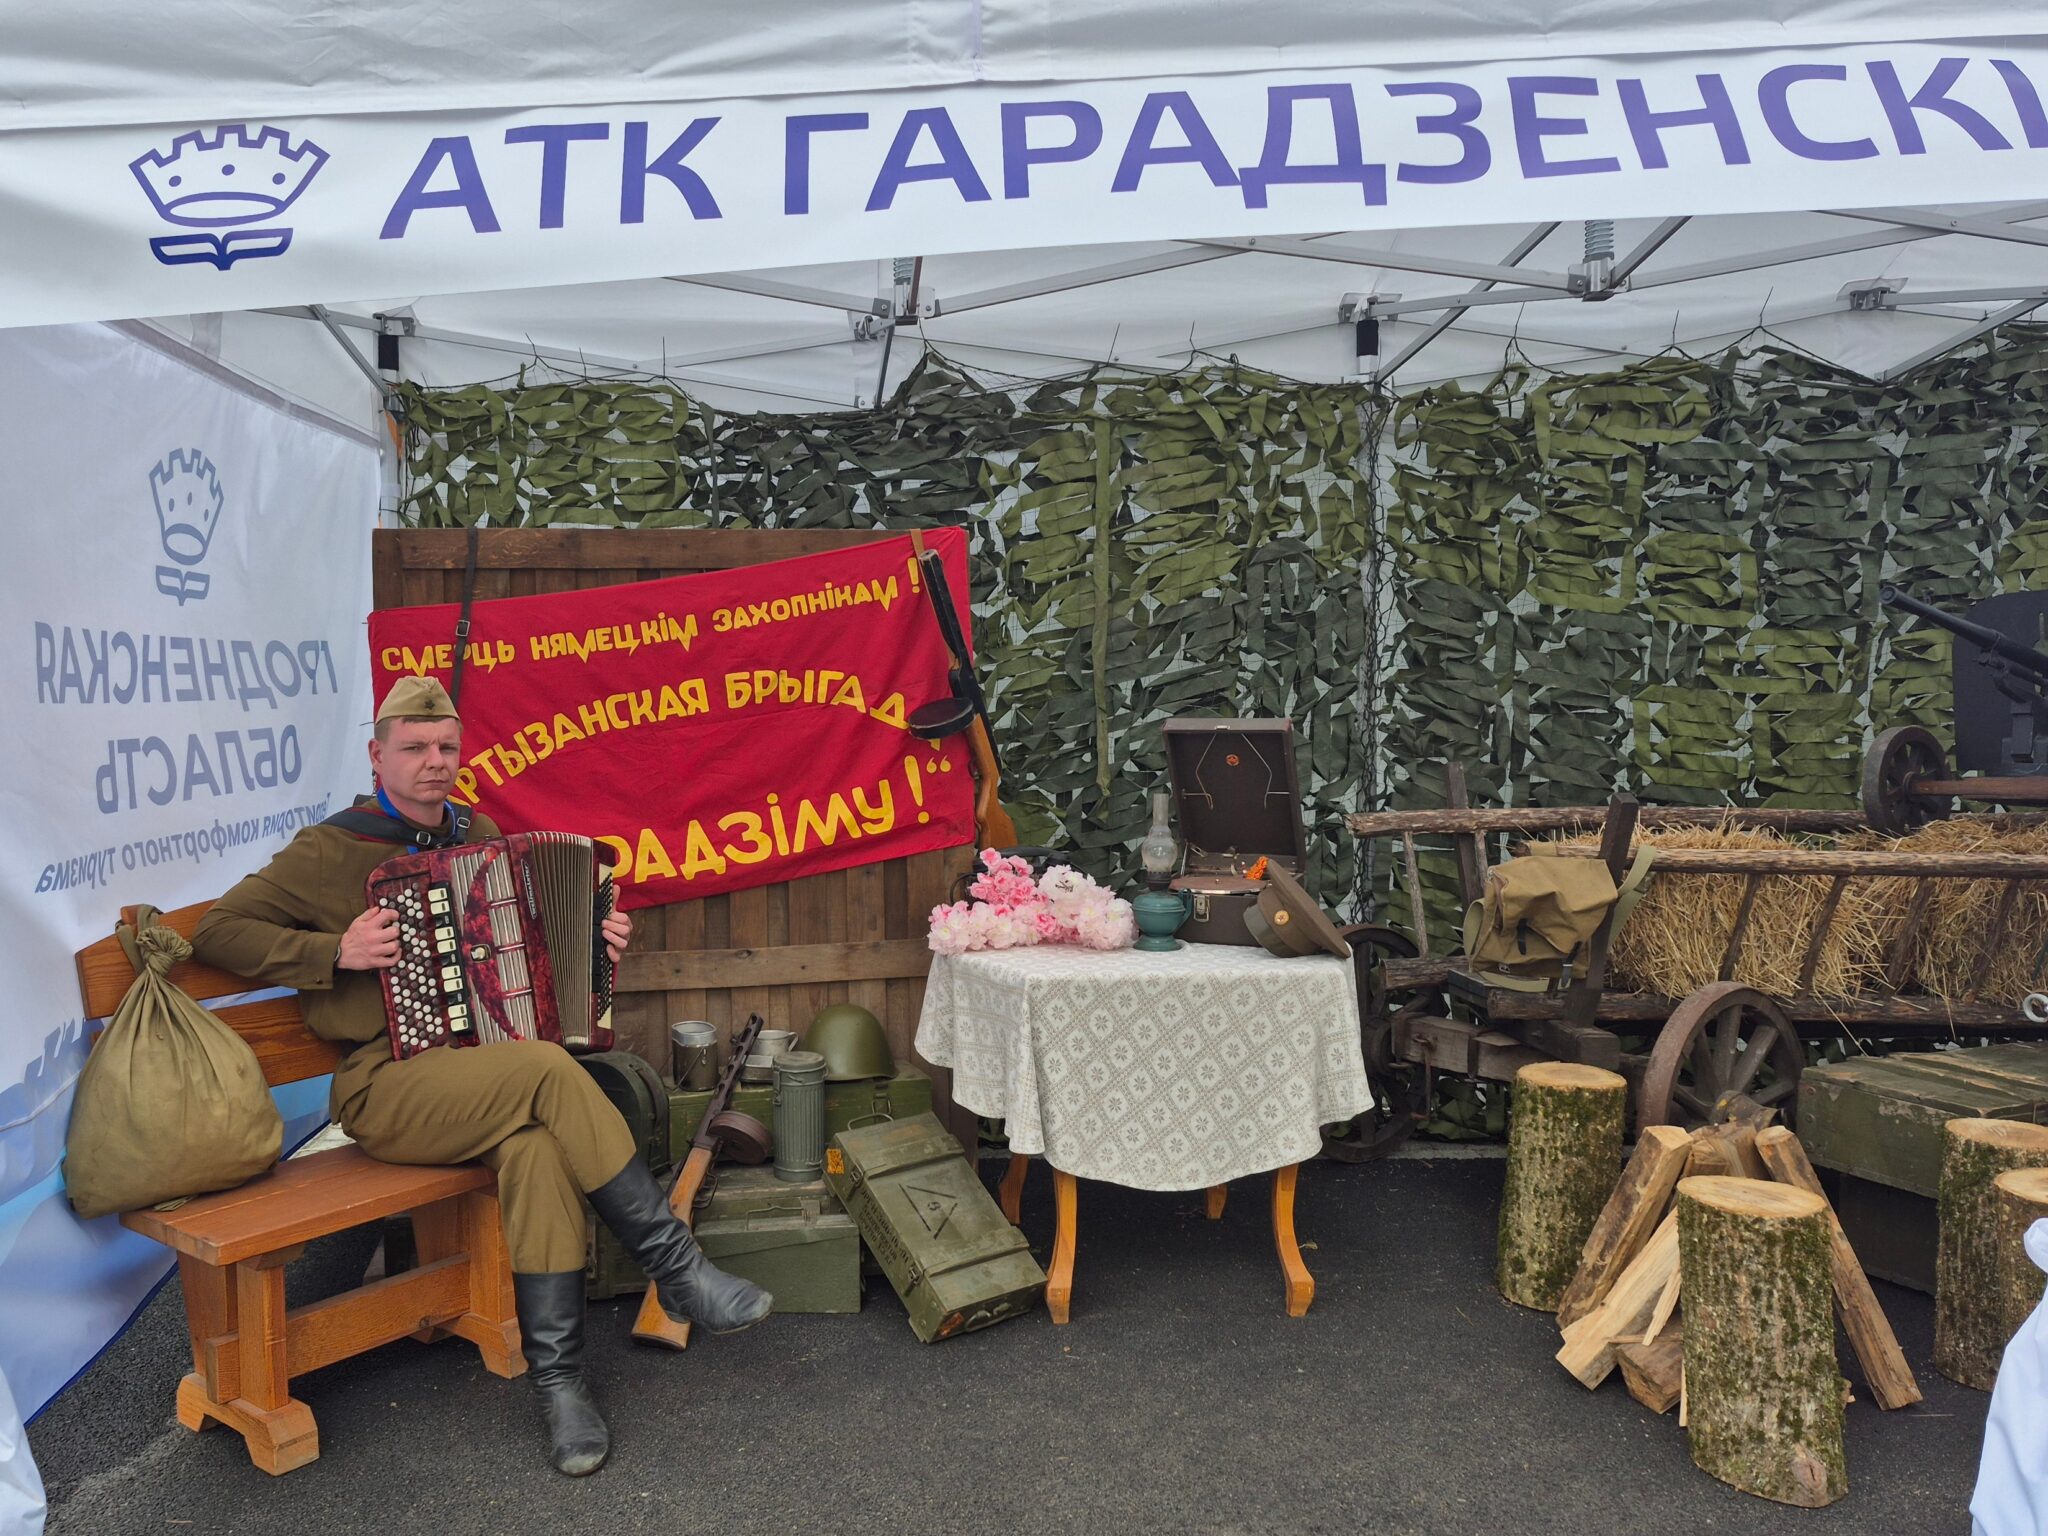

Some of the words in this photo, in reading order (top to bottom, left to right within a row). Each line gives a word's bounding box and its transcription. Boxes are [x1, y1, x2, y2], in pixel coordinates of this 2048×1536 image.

[379, 116, 723, 240] АТК
[531, 610, 698, 664] НЯМЕЦКІМ
[446, 678, 710, 808] РТЫЗАНСКАЯ
[725, 669, 941, 751] БРЫГАД
